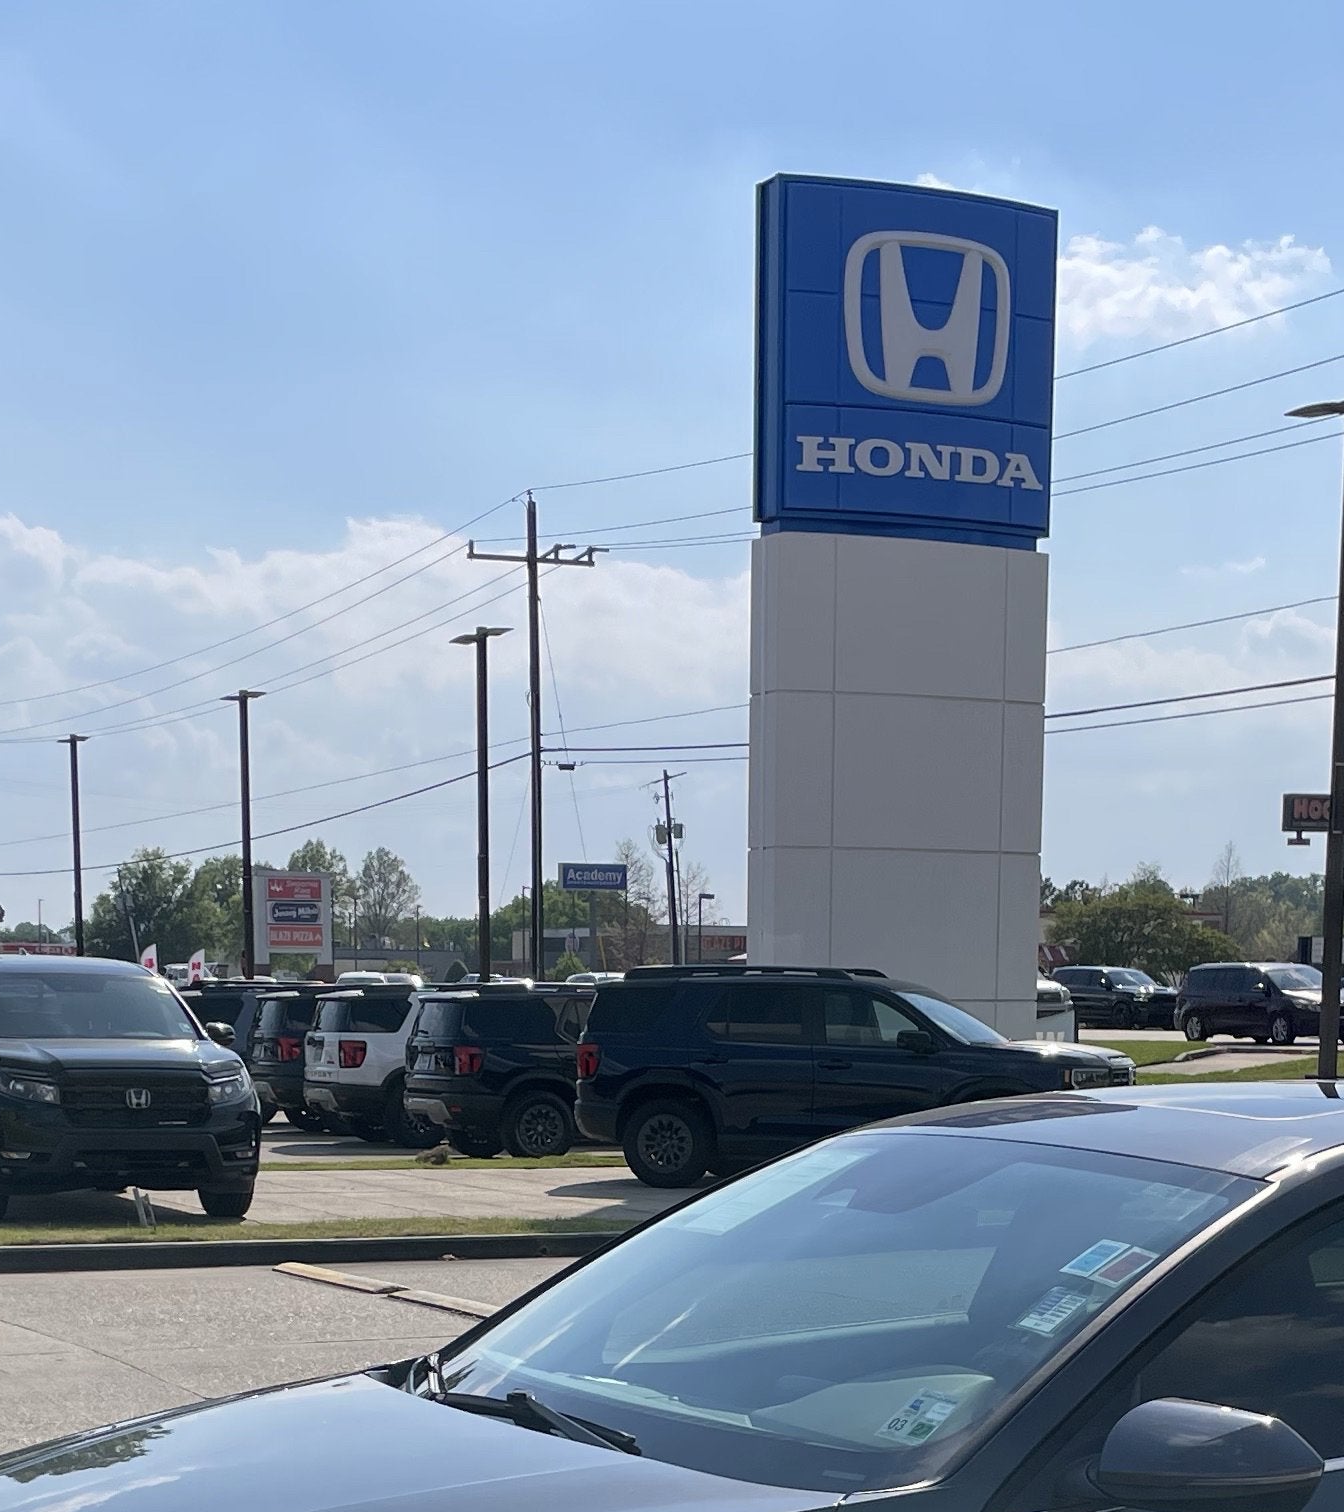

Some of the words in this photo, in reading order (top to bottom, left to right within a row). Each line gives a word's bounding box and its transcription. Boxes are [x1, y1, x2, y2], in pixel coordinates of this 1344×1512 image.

[795, 435, 1043, 491] HONDA
[566, 867, 623, 885] Academy
[887, 1417, 908, 1431] 03
